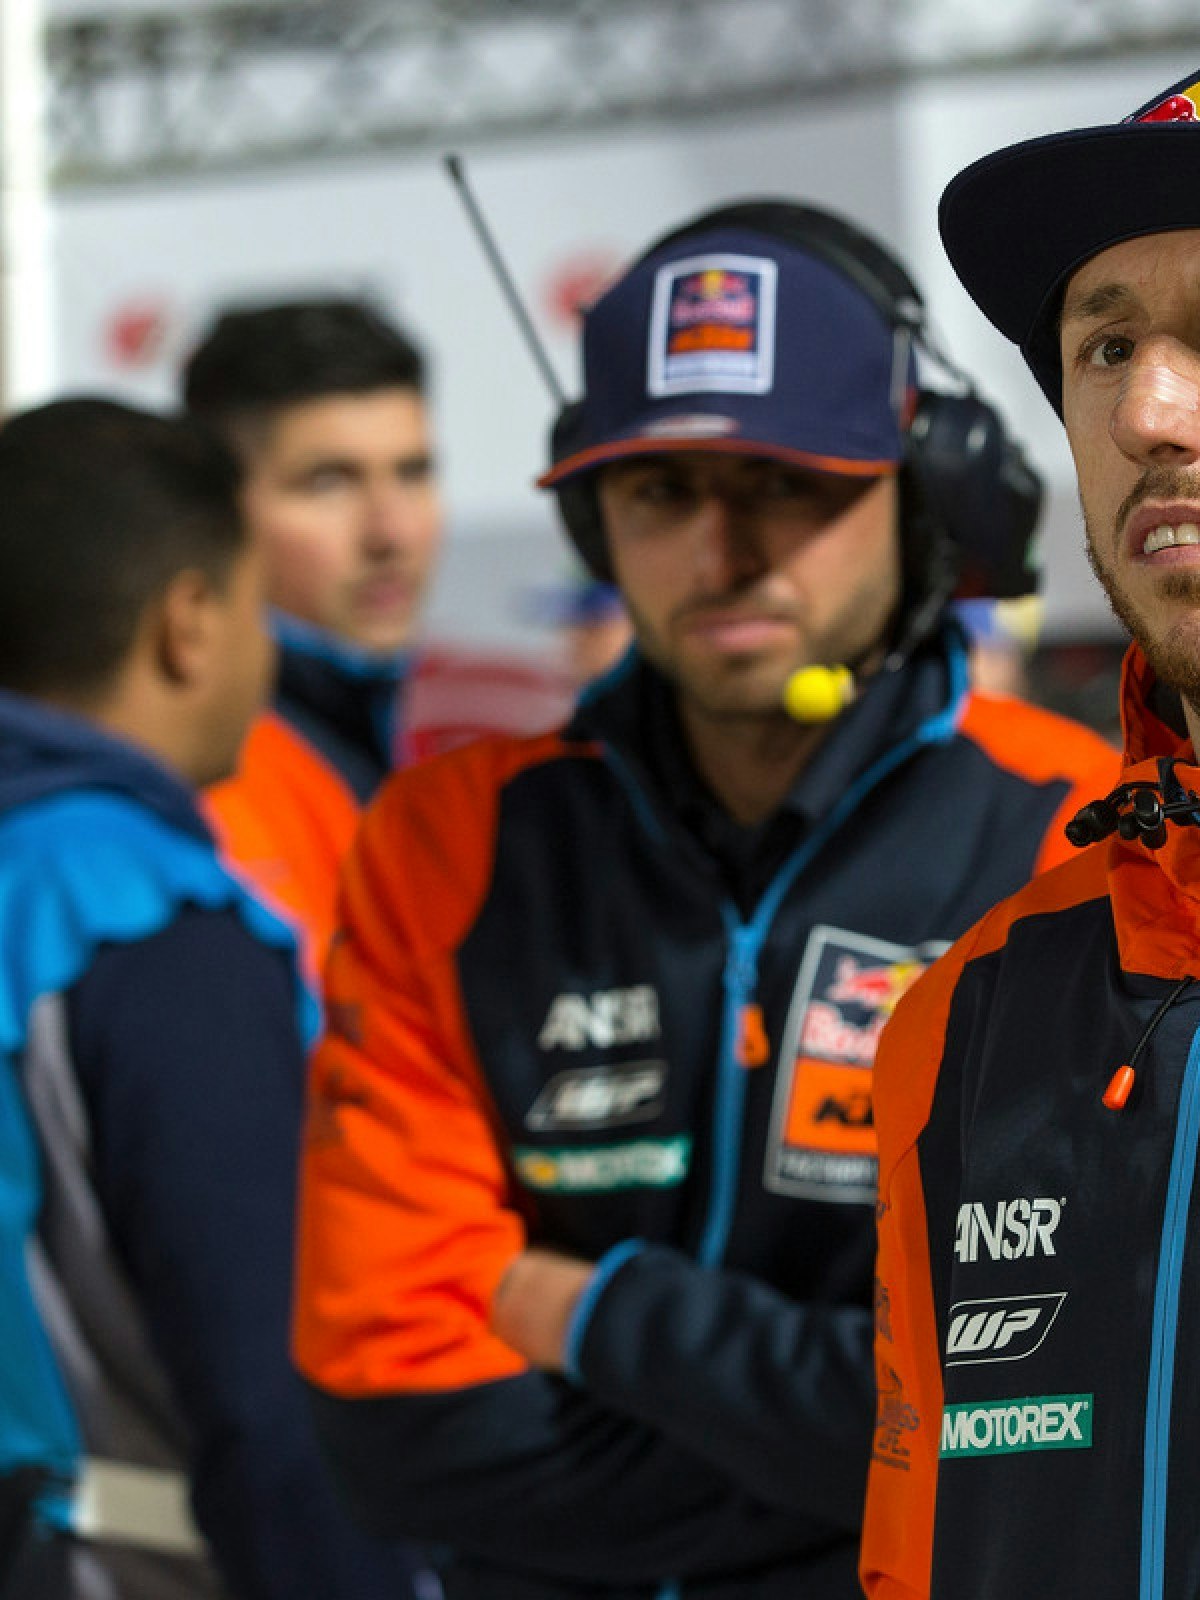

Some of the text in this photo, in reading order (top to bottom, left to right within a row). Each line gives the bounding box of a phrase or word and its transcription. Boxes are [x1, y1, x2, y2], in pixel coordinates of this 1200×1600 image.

[954, 1197, 1061, 1262] ANSR
[946, 1308, 1043, 1354] WP
[942, 1401, 1084, 1450] MOTOREX
